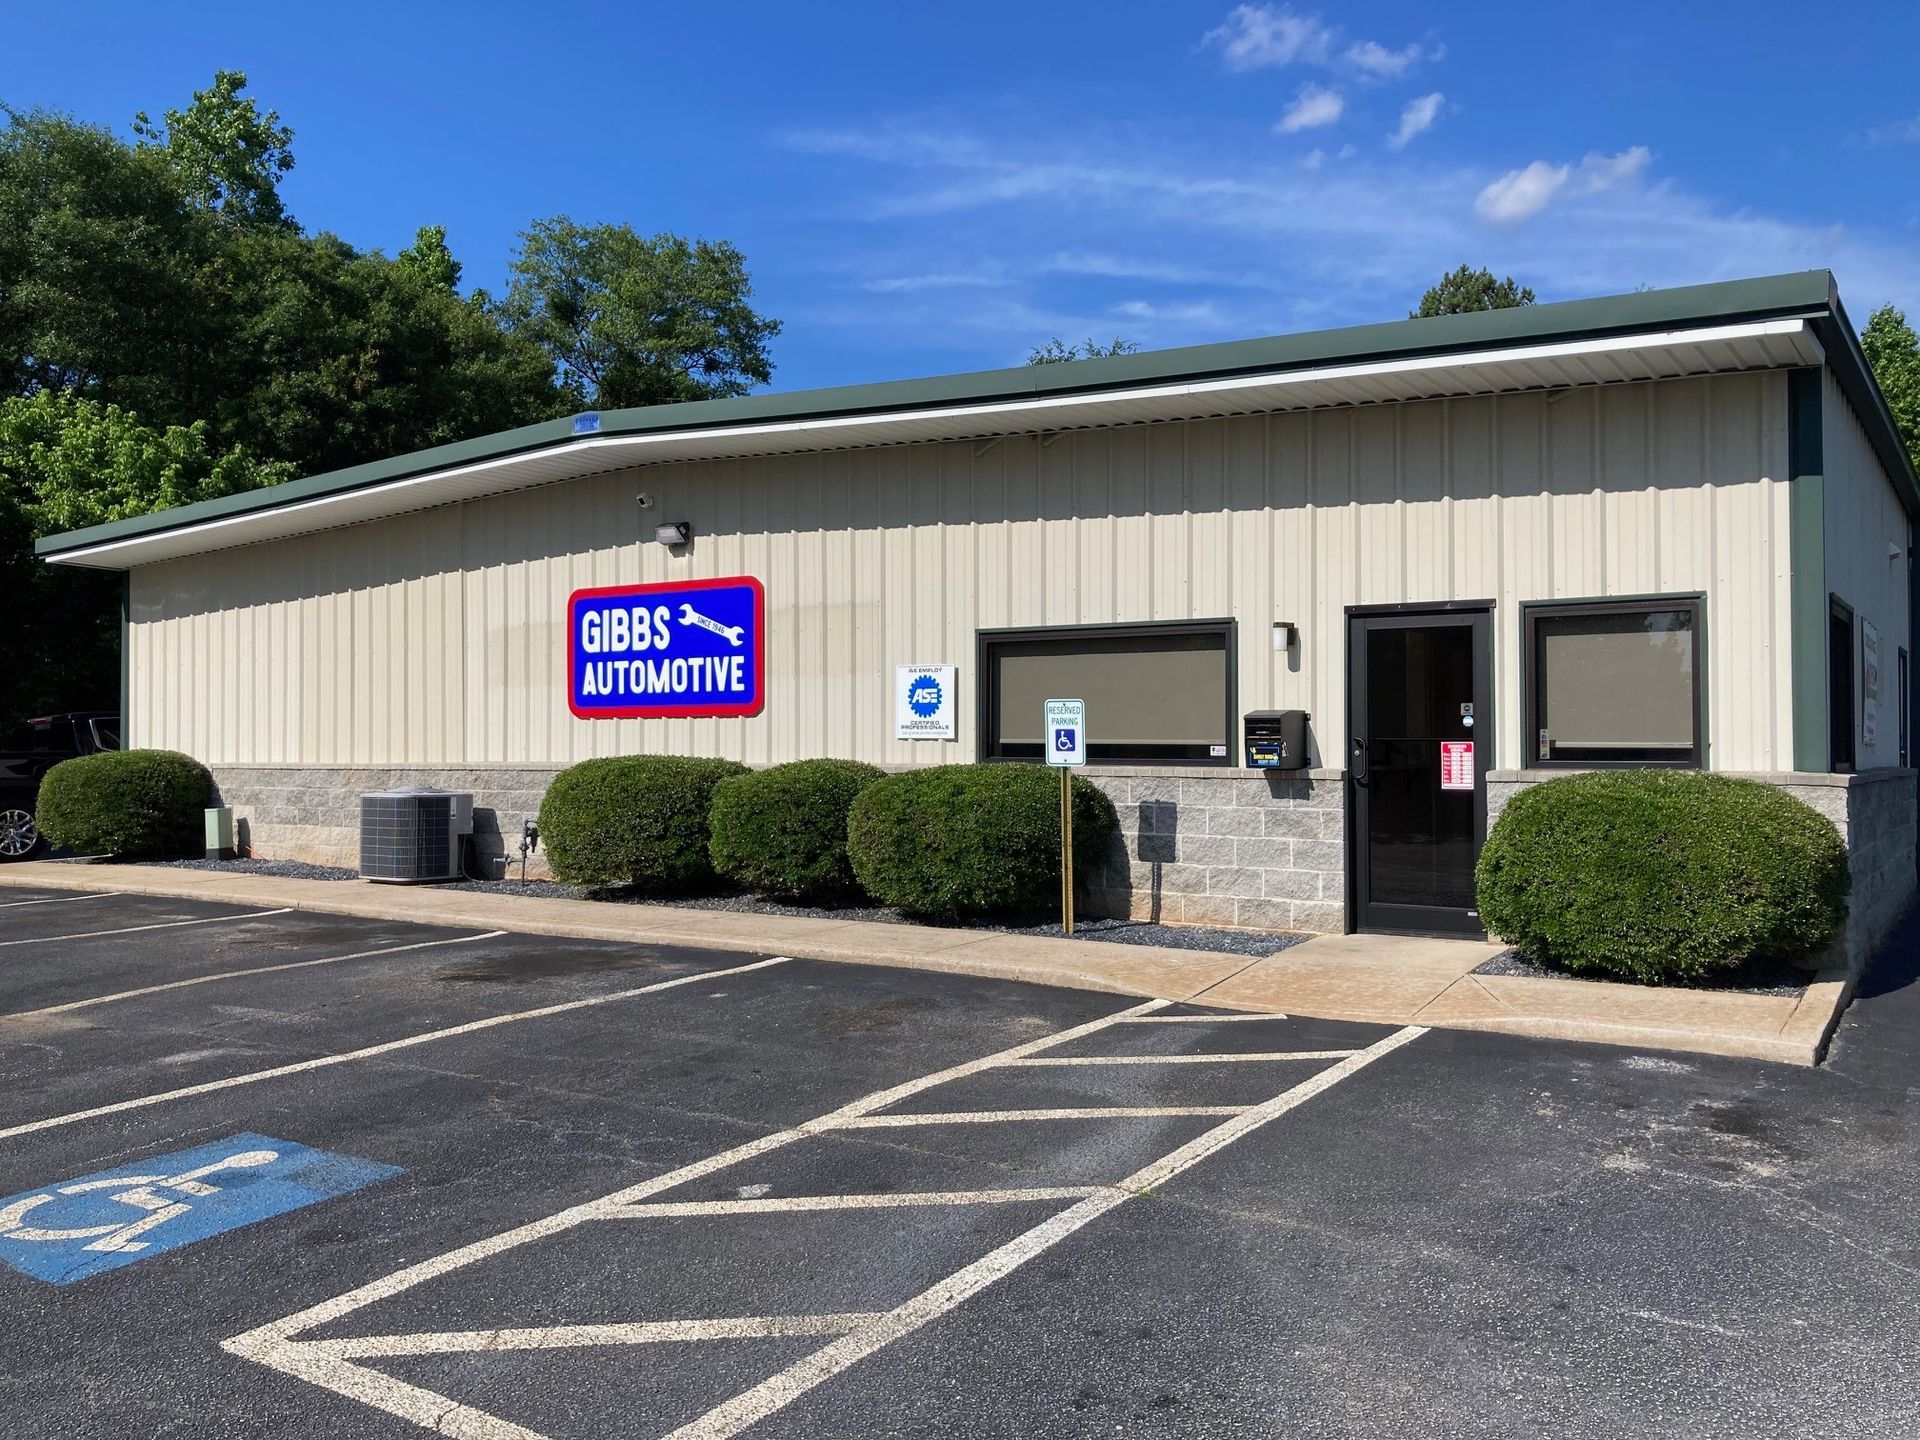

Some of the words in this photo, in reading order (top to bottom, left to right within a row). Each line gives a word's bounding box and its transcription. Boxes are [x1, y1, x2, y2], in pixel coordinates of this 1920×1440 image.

[582, 605, 670, 653] GIBBS
[697, 616, 711, 628] SINCE
[712, 622, 726, 634] 1946
[582, 655, 745, 696] AUTOMOTIVE
[911, 688, 938, 704] ASE
[1049, 706, 1081, 715] RESERVED
[1051, 717, 1079, 726] PARKING
